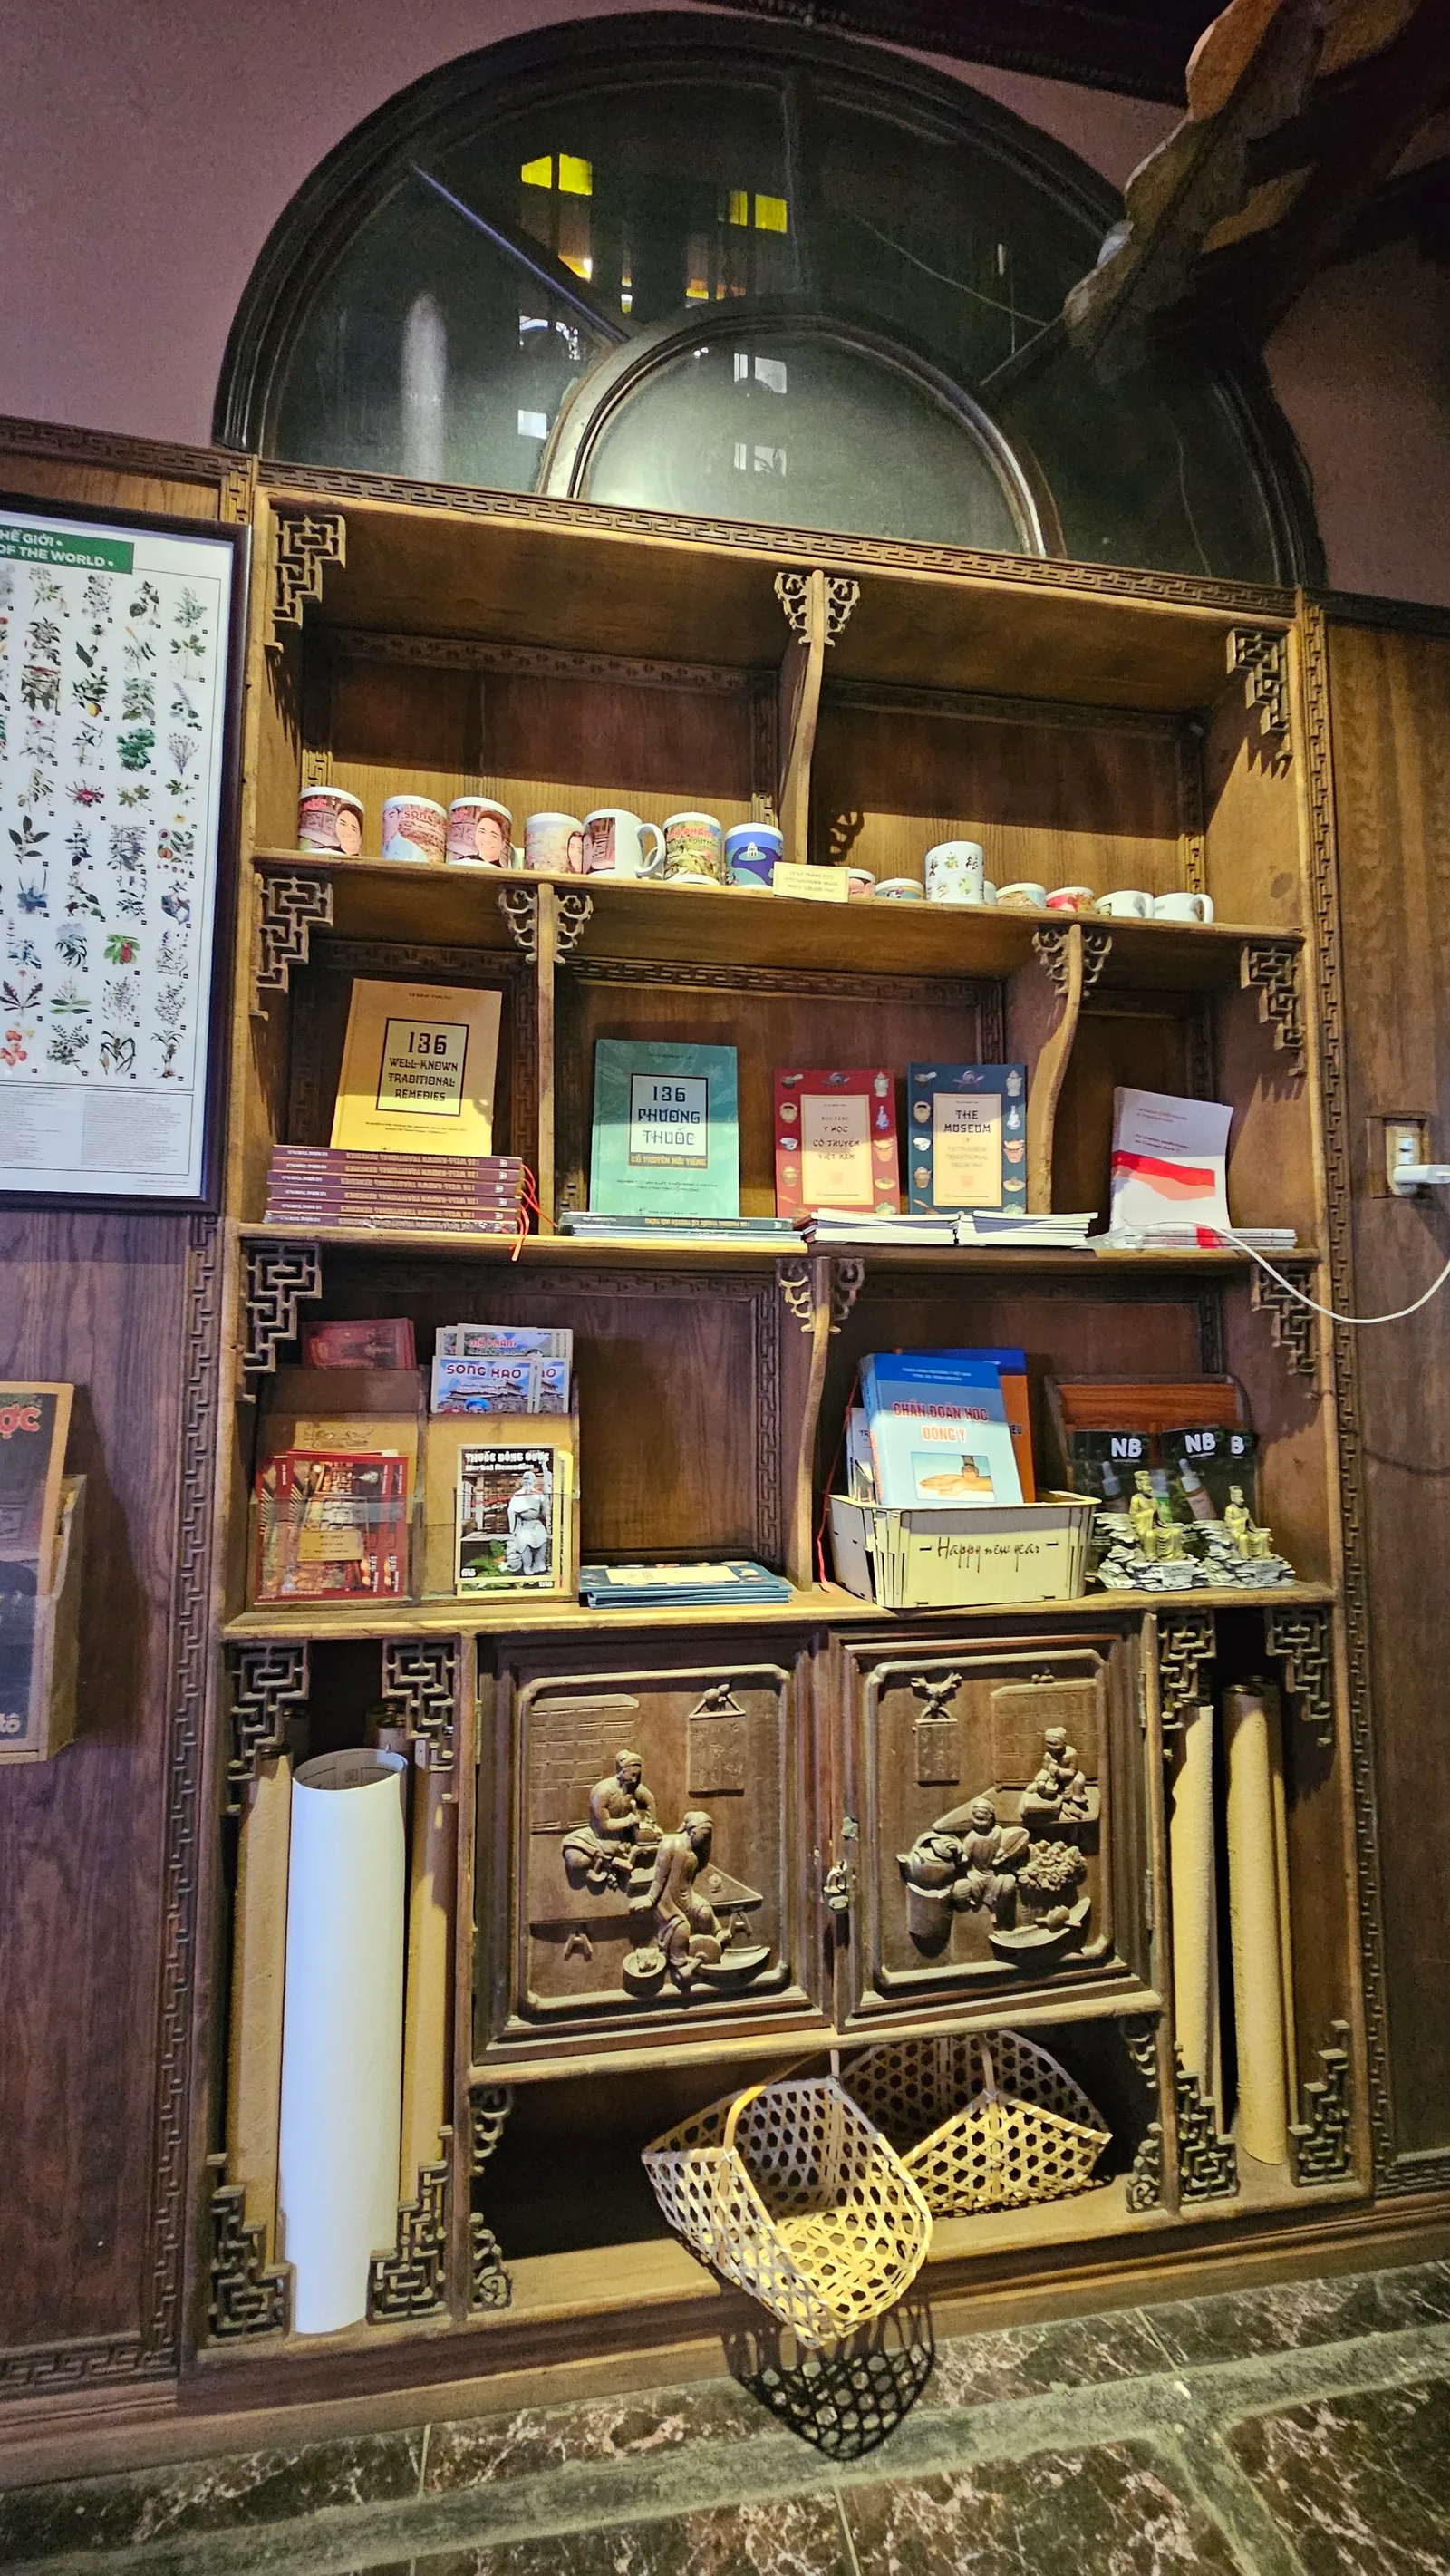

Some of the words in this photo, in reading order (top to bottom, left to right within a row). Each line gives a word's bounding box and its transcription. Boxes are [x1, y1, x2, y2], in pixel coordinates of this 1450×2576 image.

[0, 528, 22, 543] HẾ
[23, 532, 54, 547] GIỚI
[0, 544, 17, 556] OF
[19, 547, 48, 560] THE
[51, 551, 106, 567] WORLD
[408, 1031, 447, 1055] 136
[389, 1057, 459, 1072] WELL-KNOWN
[388, 1072, 456, 1088] TRADITIONAL
[395, 1089, 446, 1102] REMEDIES
[652, 1086, 686, 1102] 136
[638, 1107, 701, 1124] PHƯƠNG
[955, 1109, 979, 1119] THE
[643, 1127, 695, 1146] THUỐC
[446, 1364, 487, 1376] SONG
[893, 1398, 926, 1418] CHẨN
[964, 1407, 989, 1424] HỌC
[0, 1403, 42, 1440] ợc
[959, 1428, 967, 1443] Y
[1184, 1432, 1216, 1454] NB
[1110, 1438, 1142, 1457] NB
[1230, 1436, 1245, 1454] B
[937, 1536, 981, 1574] Happy
[984, 1544, 1011, 1555] new
